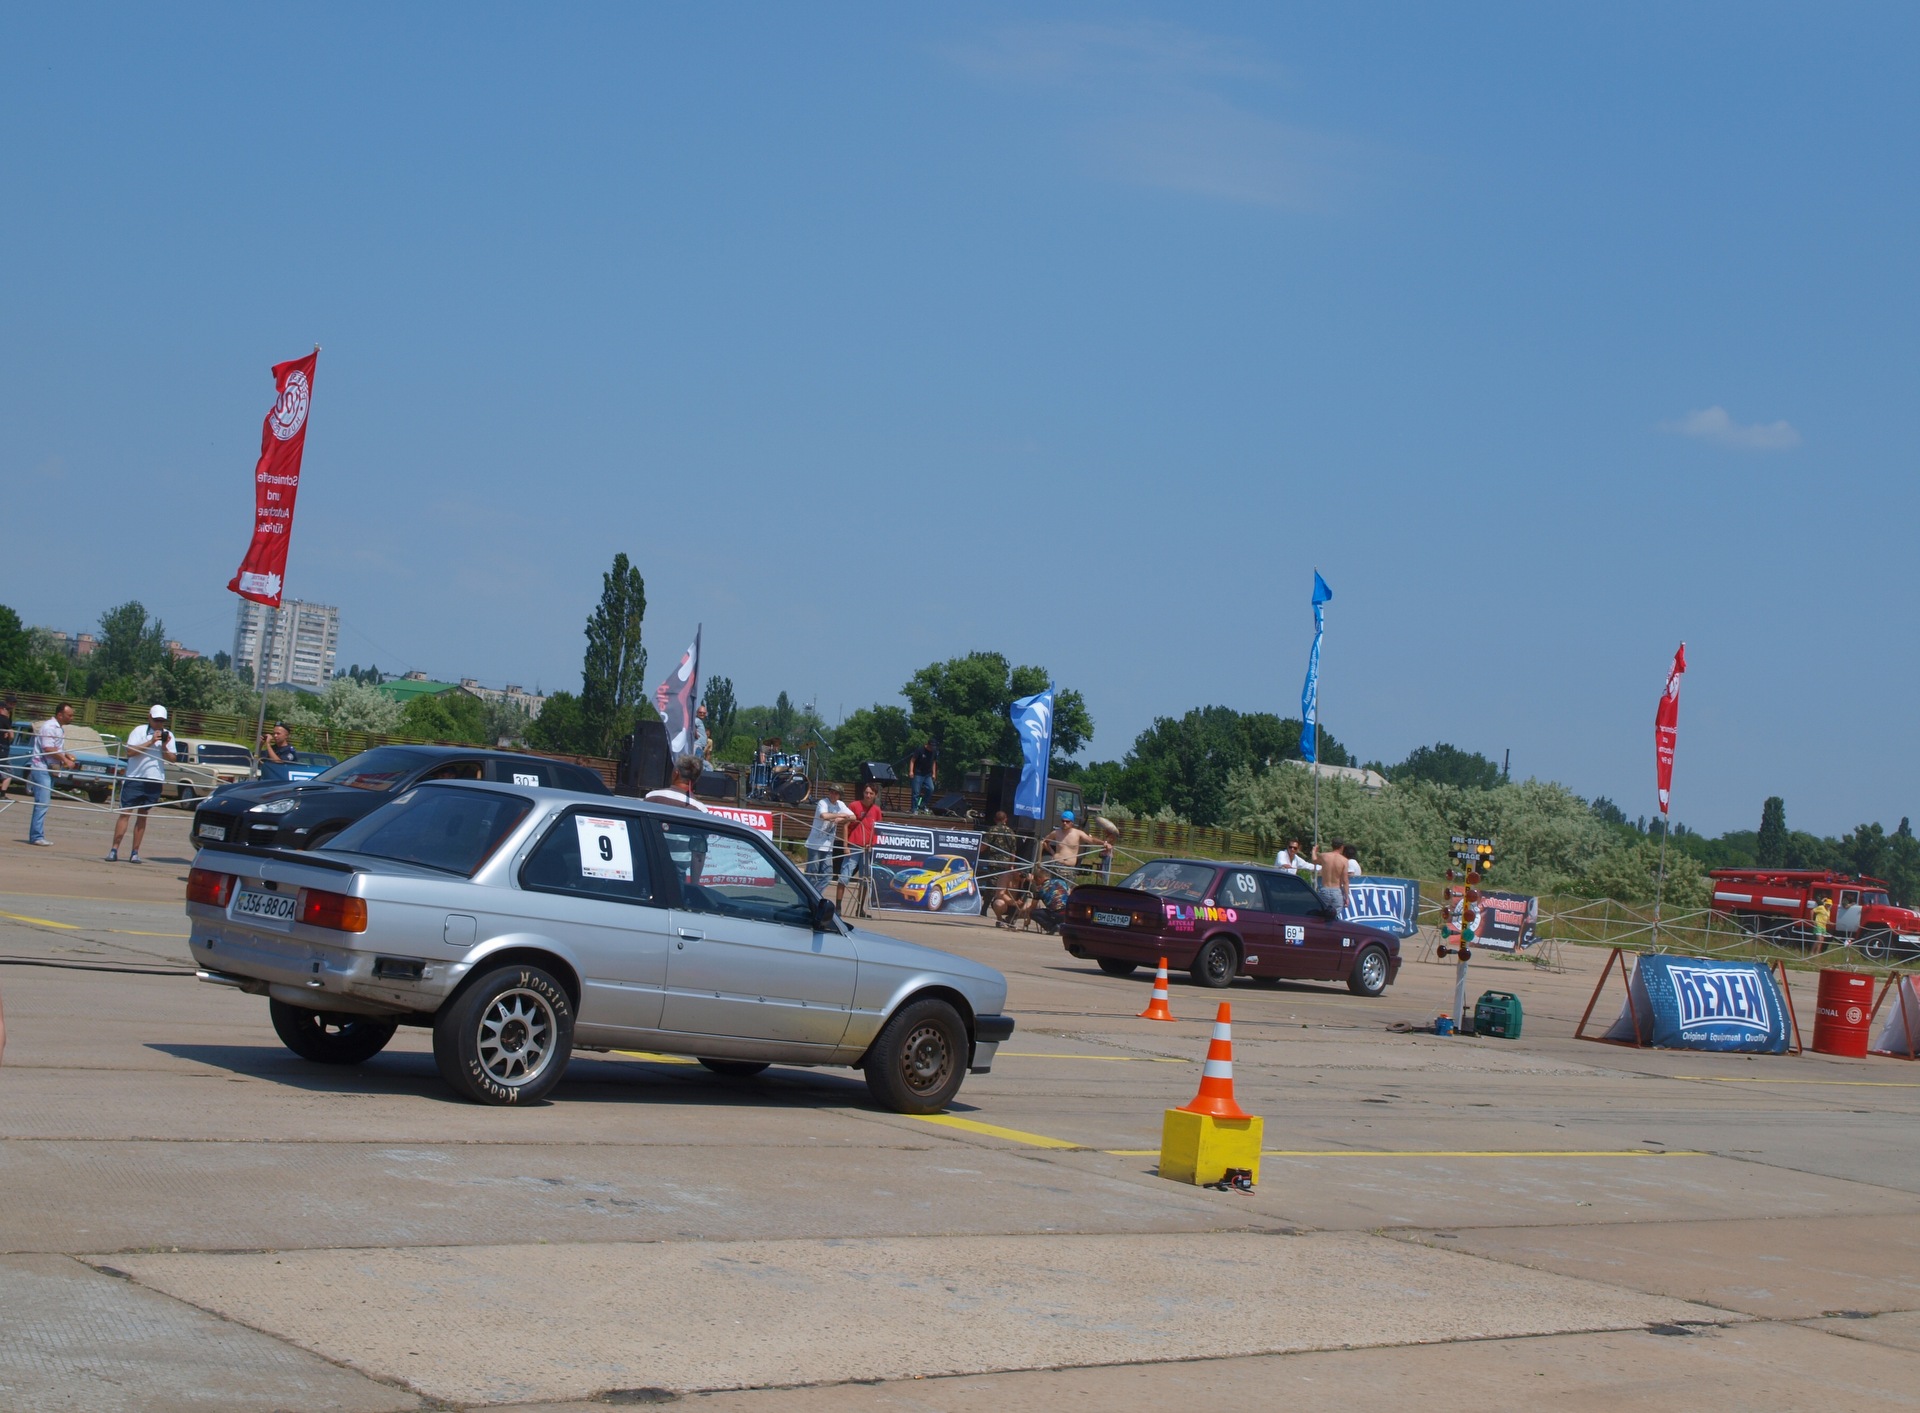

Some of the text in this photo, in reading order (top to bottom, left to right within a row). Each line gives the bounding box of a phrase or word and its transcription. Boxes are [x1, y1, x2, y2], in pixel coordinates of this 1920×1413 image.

[876, 835, 930, 849] NANOPROTEC
[1451, 836, 1489, 846] PRE-STAGE
[597, 834, 614, 862] 9
[875, 853, 912, 861] ПРОВЕРЕНО
[1456, 852, 1481, 861] STAGE
[1236, 872, 1257, 894] 69
[1165, 904, 1238, 923] FLAMINGO
[1286, 928, 1297, 938] 69
[516, 971, 568, 1016] Hoosier
[1682, 1031, 1768, 1044] Original Equipment Quality
